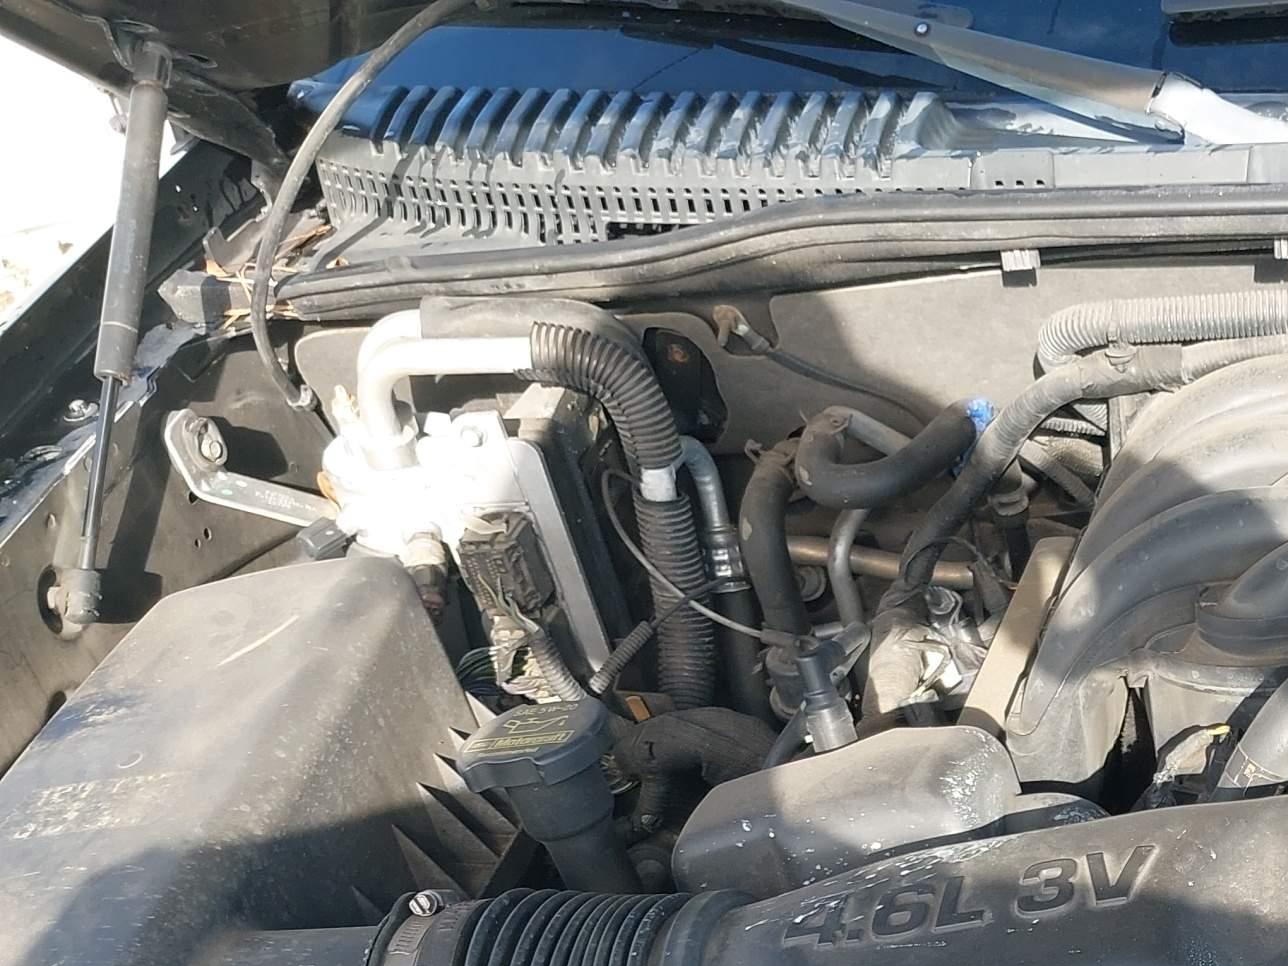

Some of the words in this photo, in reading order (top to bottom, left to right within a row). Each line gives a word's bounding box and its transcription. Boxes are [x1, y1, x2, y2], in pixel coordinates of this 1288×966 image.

[514, 706, 536, 717] SAE
[494, 732, 567, 748] Motorcraft
[783, 874, 994, 947] 4.6L
[1012, 844, 1159, 919] 3V
